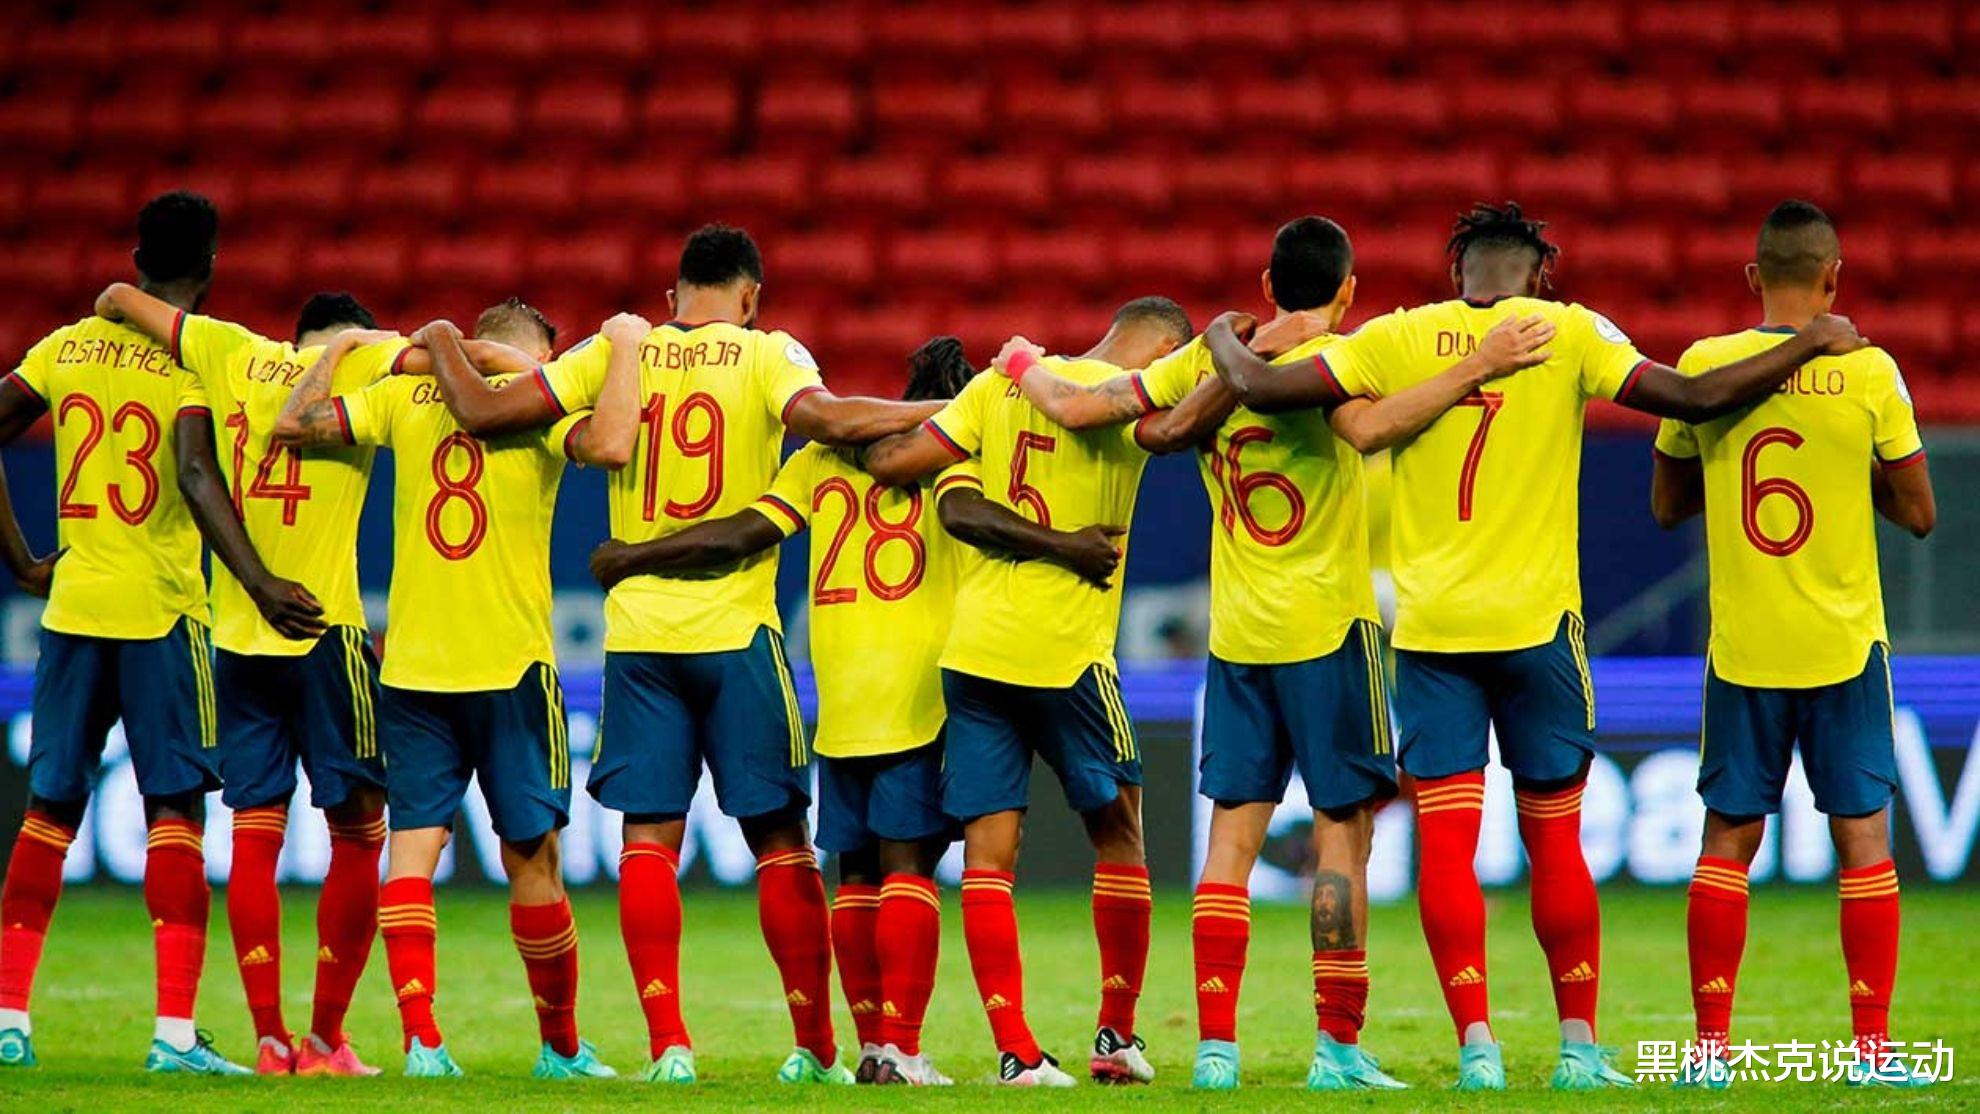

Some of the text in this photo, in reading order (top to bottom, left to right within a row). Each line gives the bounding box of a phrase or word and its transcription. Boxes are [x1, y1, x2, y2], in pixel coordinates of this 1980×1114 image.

[59, 393, 160, 526] 23
[225, 401, 311, 526] 14
[426, 431, 488, 560] 8
[641, 392, 725, 521] 19
[1008, 430, 1056, 527] 5
[1207, 426, 1306, 547] 16
[1456, 390, 1504, 521] 7
[1742, 427, 1814, 557] 6
[812, 476, 926, 606] 28
